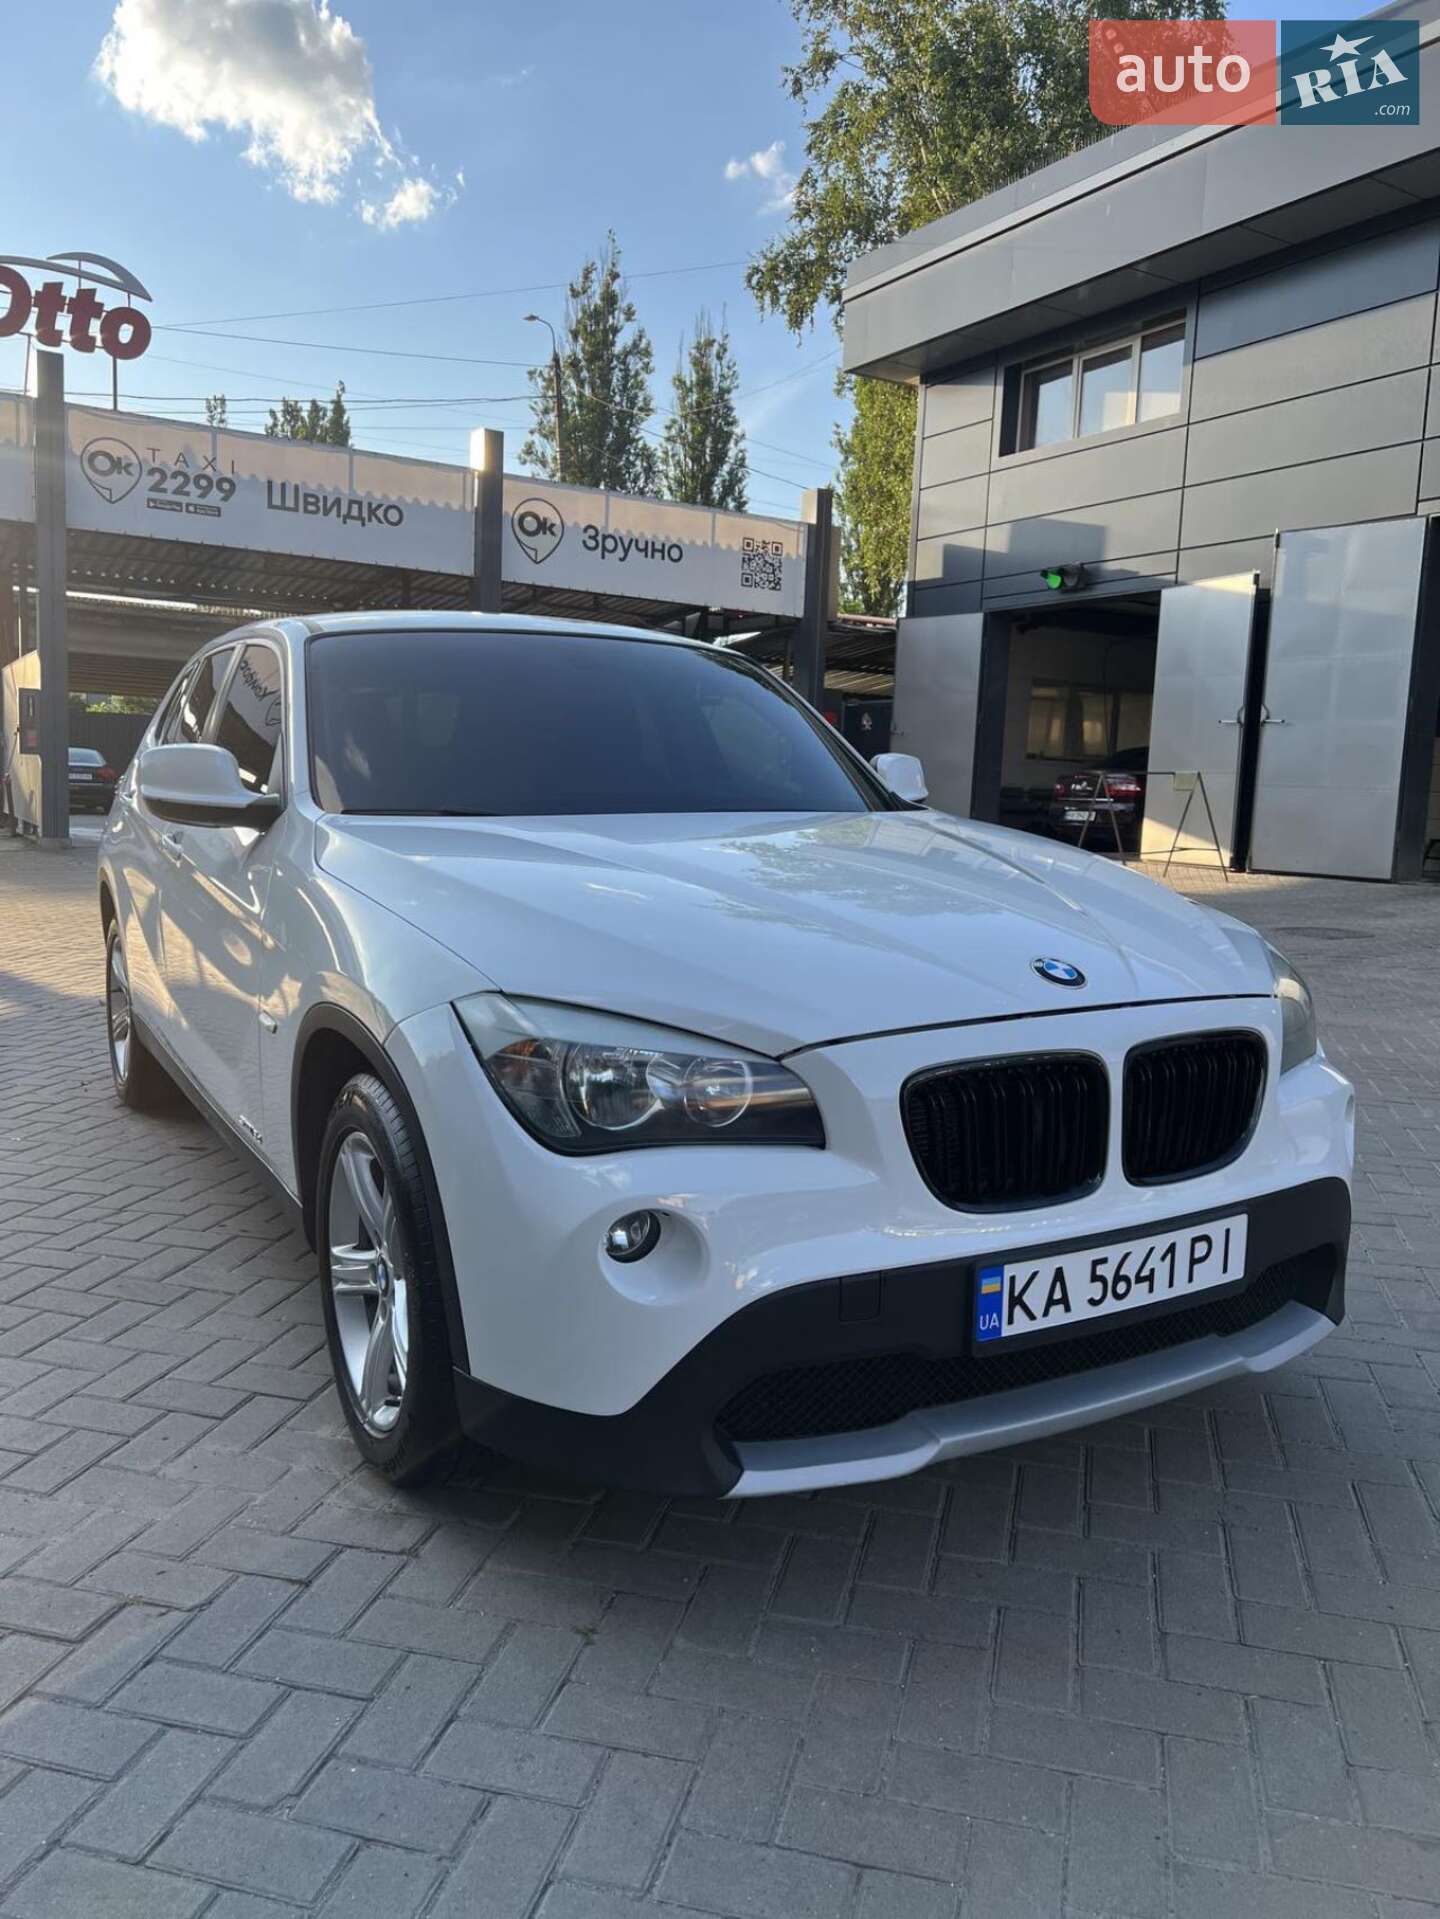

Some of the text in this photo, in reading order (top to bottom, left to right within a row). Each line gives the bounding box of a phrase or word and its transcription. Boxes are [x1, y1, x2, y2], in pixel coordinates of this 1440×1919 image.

[88, 450, 134, 477] Ok
[146, 447, 235, 474] TAXI
[147, 467, 237, 502] 2299
[266, 480, 404, 528] Швидко
[517, 511, 557, 538] Ok
[581, 525, 684, 564] Зручно
[1007, 1266, 1072, 1326] KA
[979, 1314, 1000, 1331] UA
